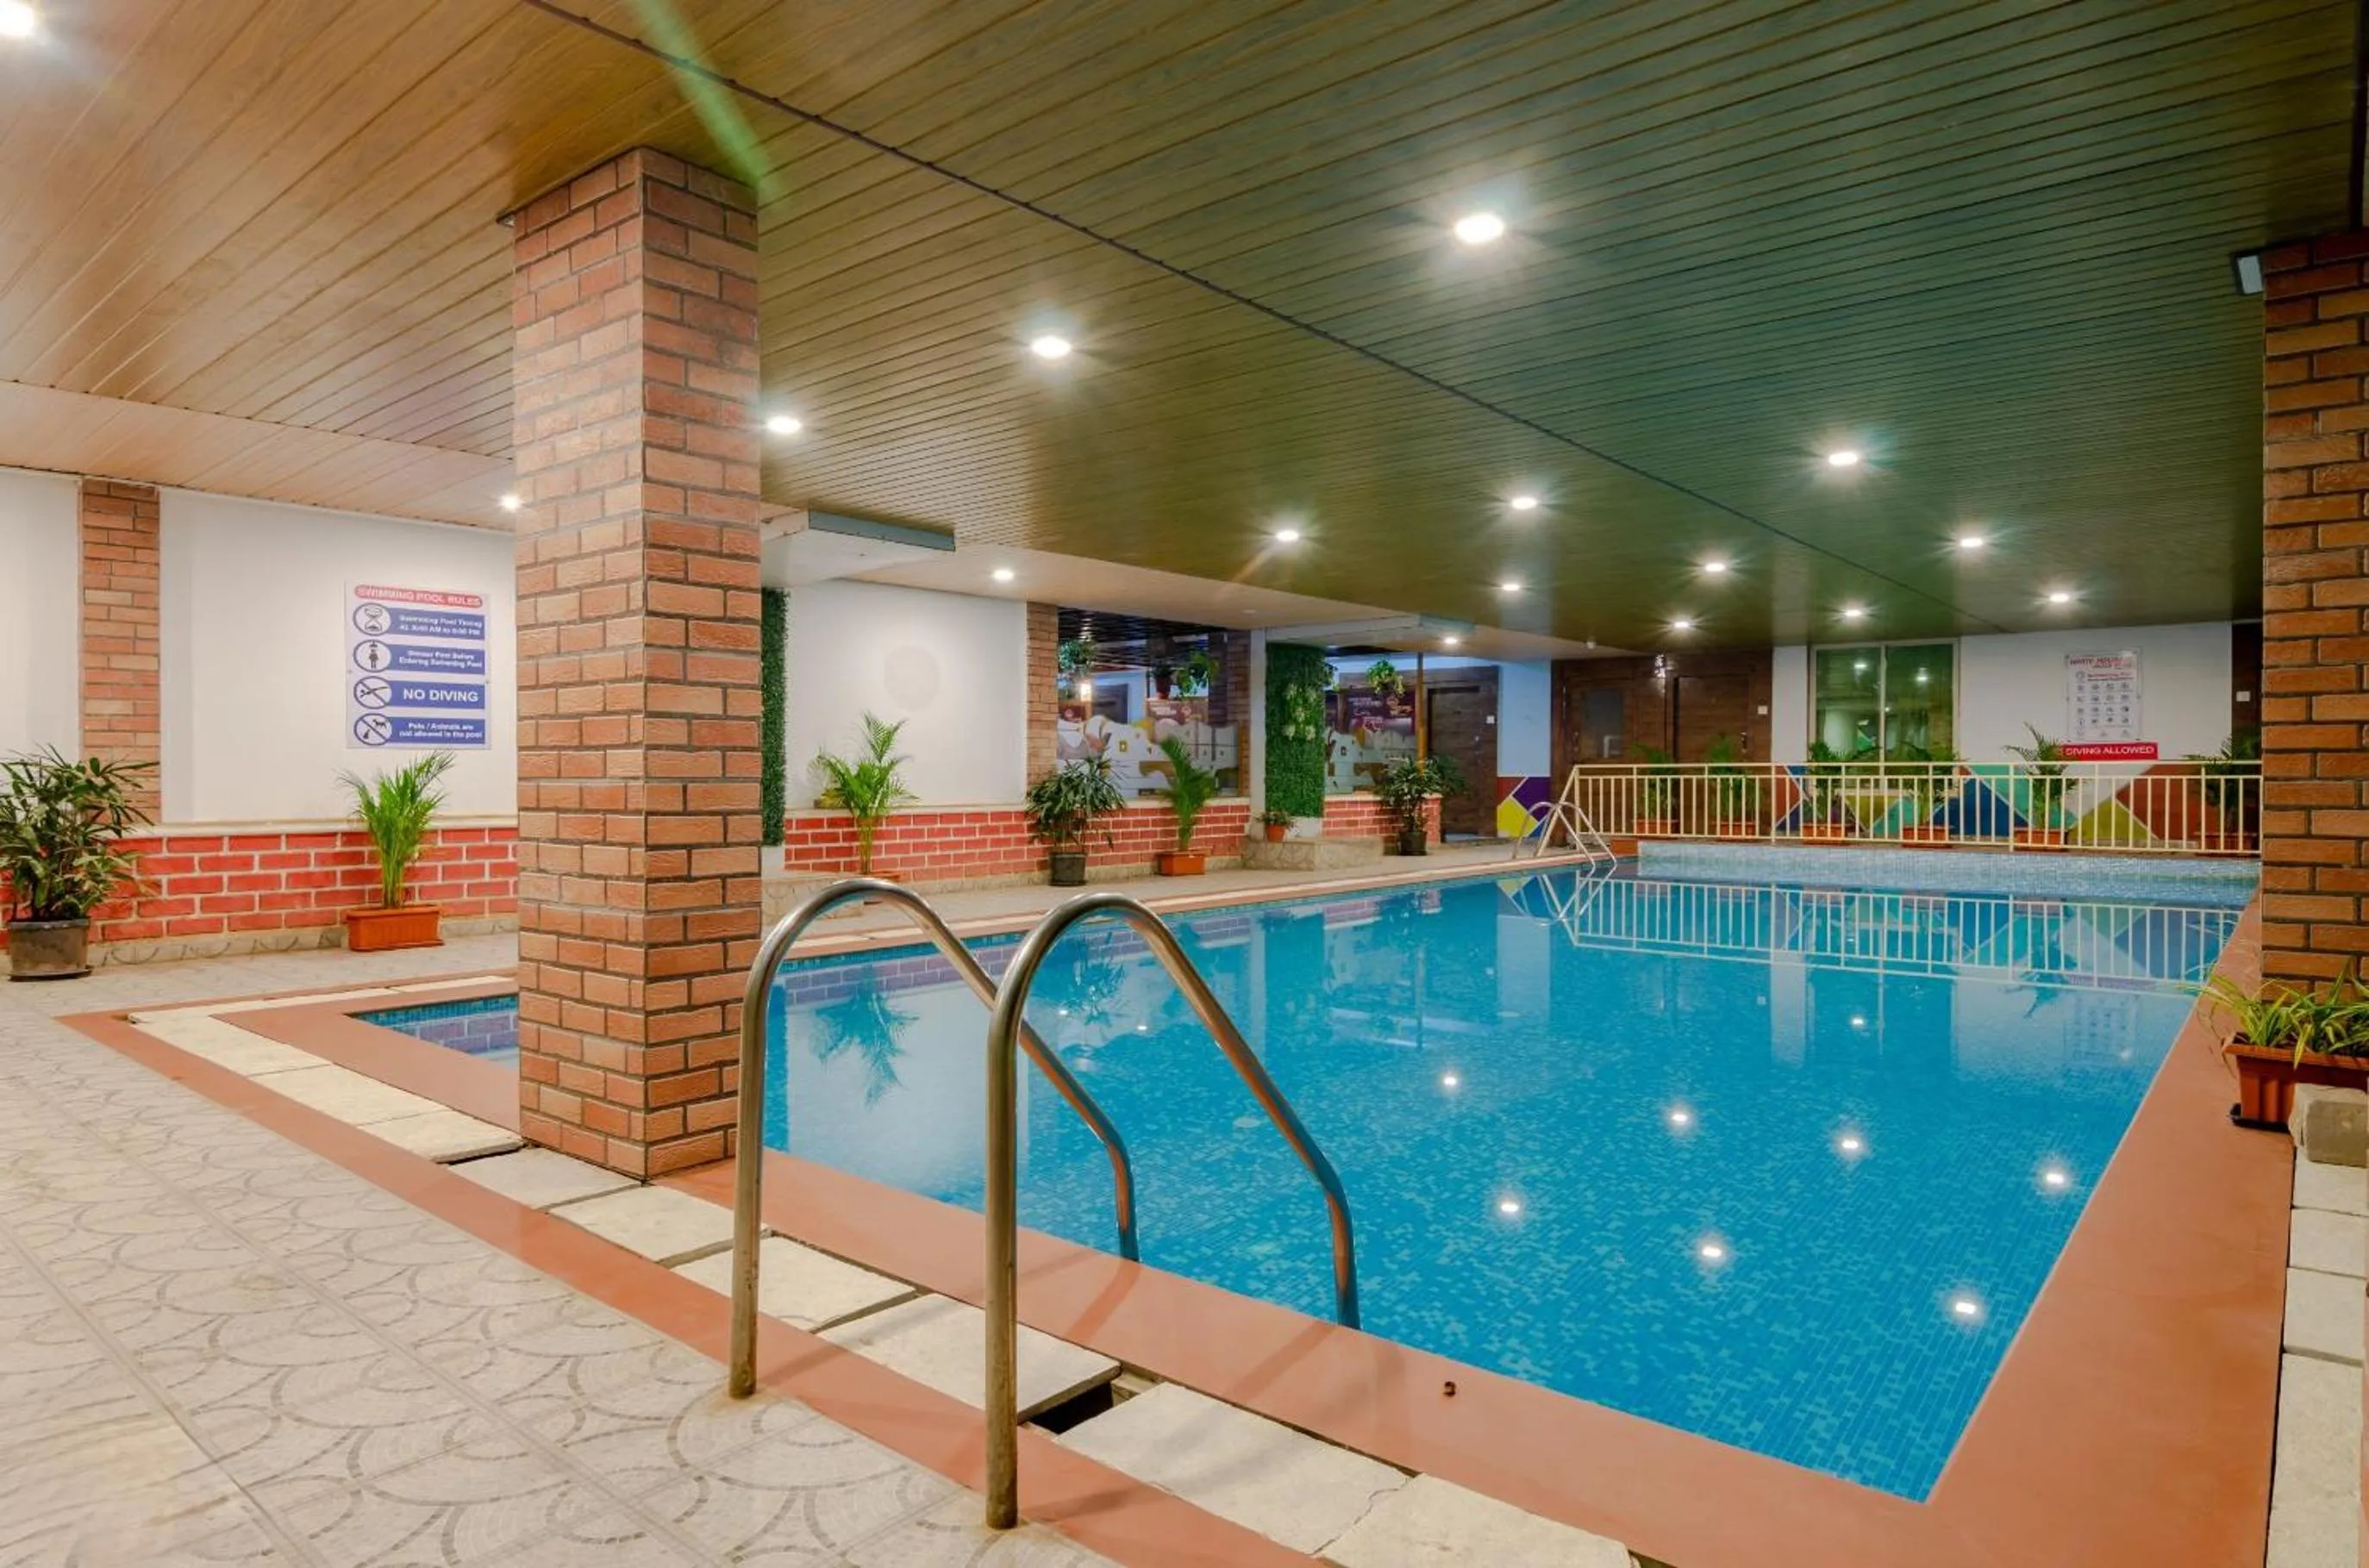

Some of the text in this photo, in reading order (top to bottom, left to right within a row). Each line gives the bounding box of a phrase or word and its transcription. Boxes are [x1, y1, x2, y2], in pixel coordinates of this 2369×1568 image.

[416, 591, 445, 603] POOL
[447, 595, 481, 606] RULES
[403, 688, 478, 703] NO DIVING
[466, 731, 483, 740] pool
[2103, 746, 2154, 755] ALLOWED
